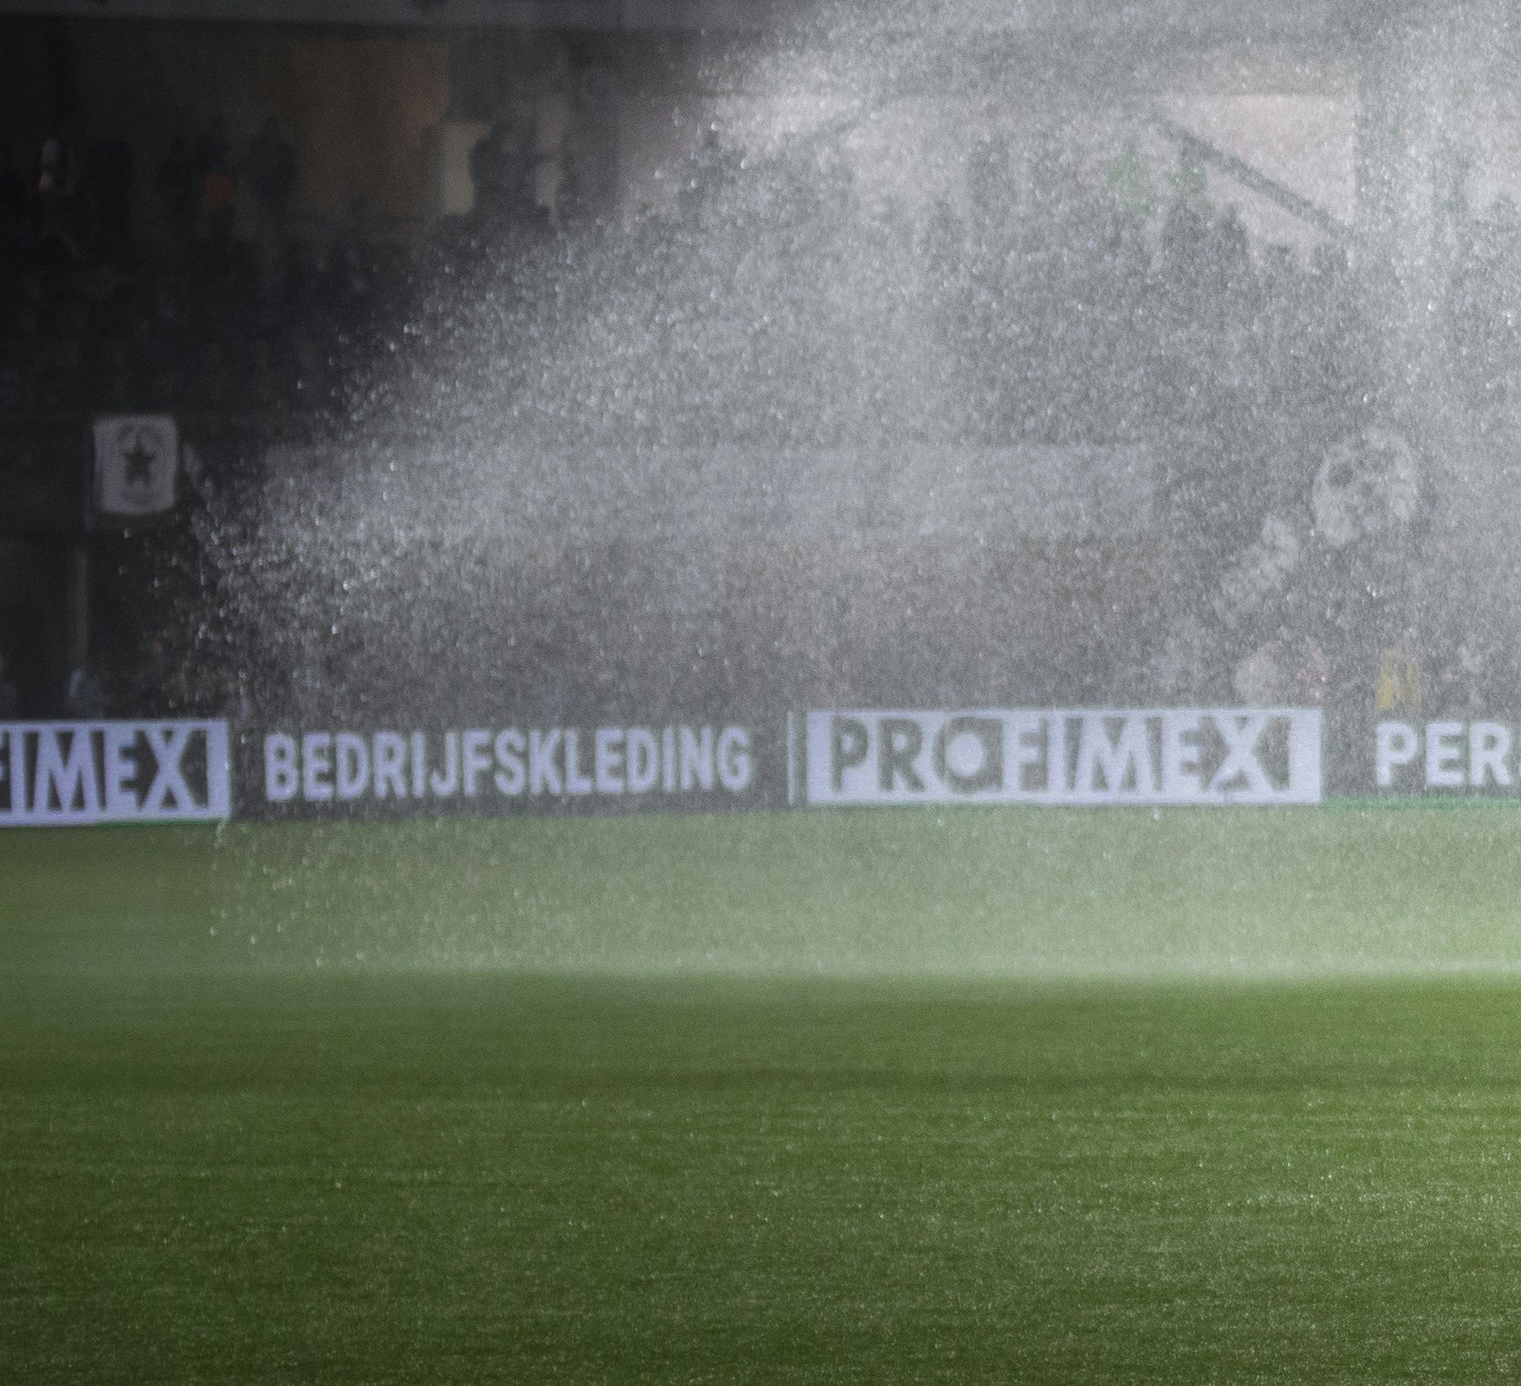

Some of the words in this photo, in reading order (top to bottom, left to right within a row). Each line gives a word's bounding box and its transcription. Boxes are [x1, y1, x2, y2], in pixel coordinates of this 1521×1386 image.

[0, 728, 197, 812] IMEX
[264, 726, 752, 801] BEDRIJFSKLEDING
[830, 715, 1287, 793] PROFIMEX
